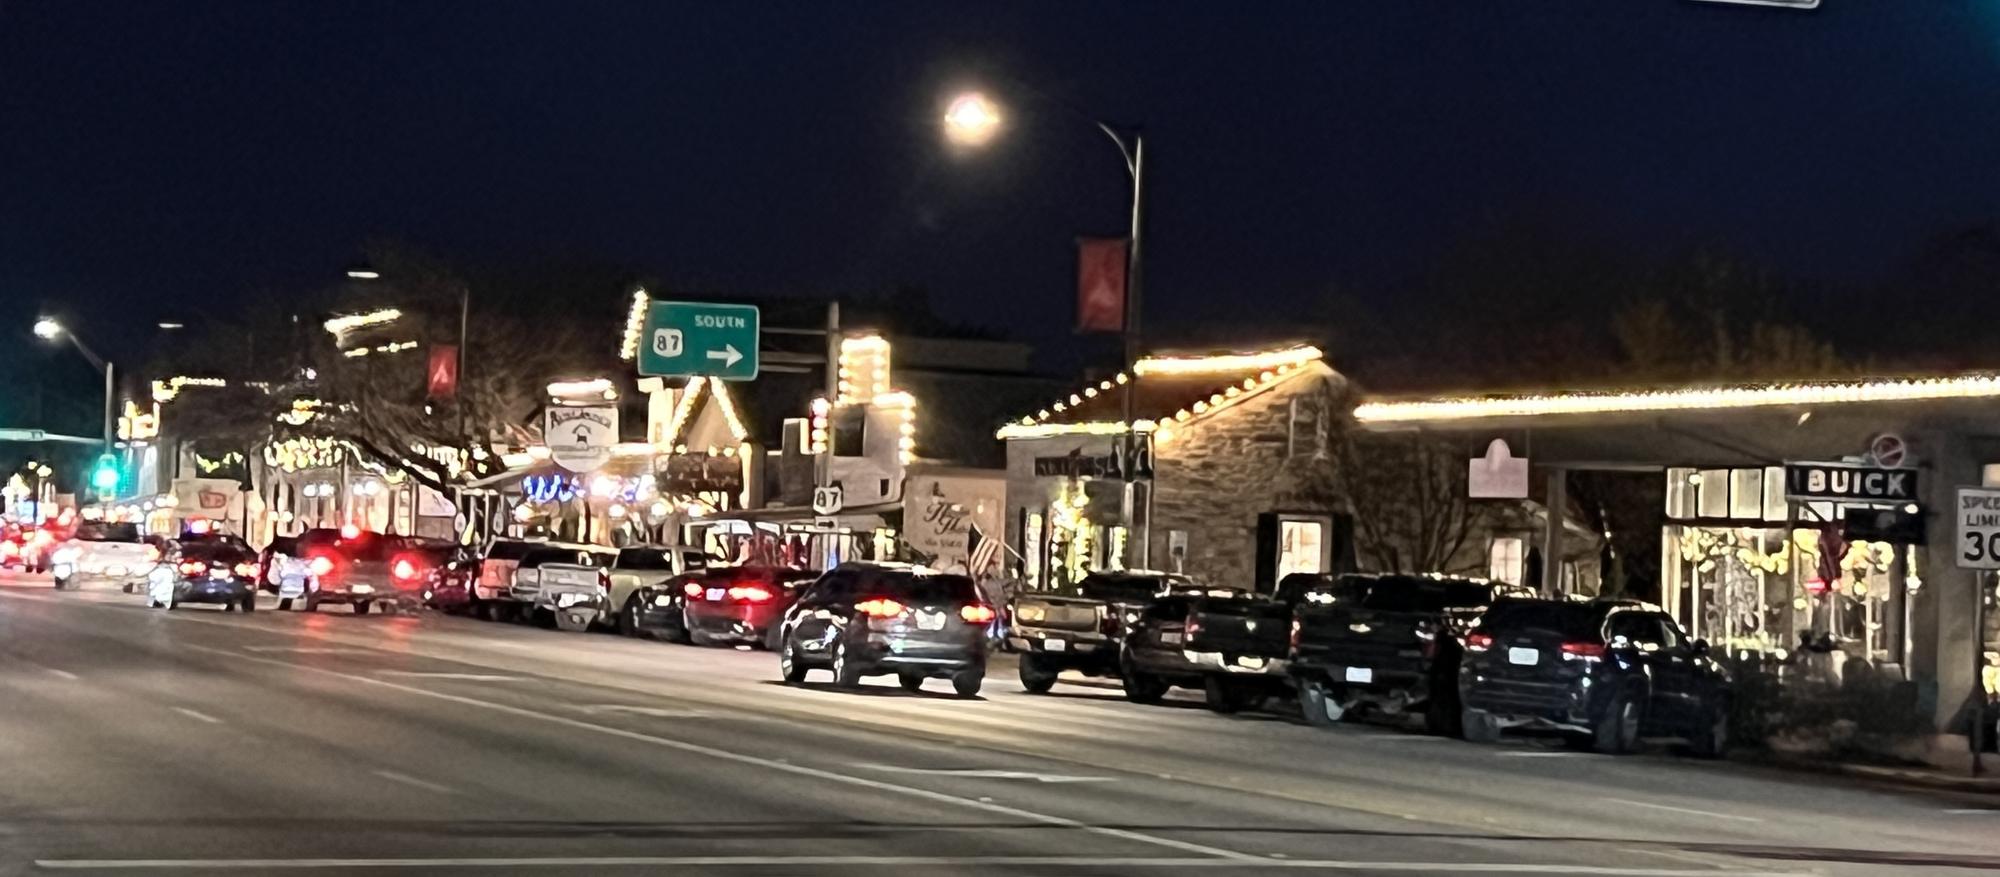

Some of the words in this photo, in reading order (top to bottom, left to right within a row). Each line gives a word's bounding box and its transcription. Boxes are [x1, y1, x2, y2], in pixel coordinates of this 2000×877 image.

[694, 314, 745, 328] SOUTH
[657, 335, 679, 351] 87
[1807, 469, 1906, 496] BUICK
[816, 490, 838, 507] 87
[1964, 531, 2000, 562] 30
